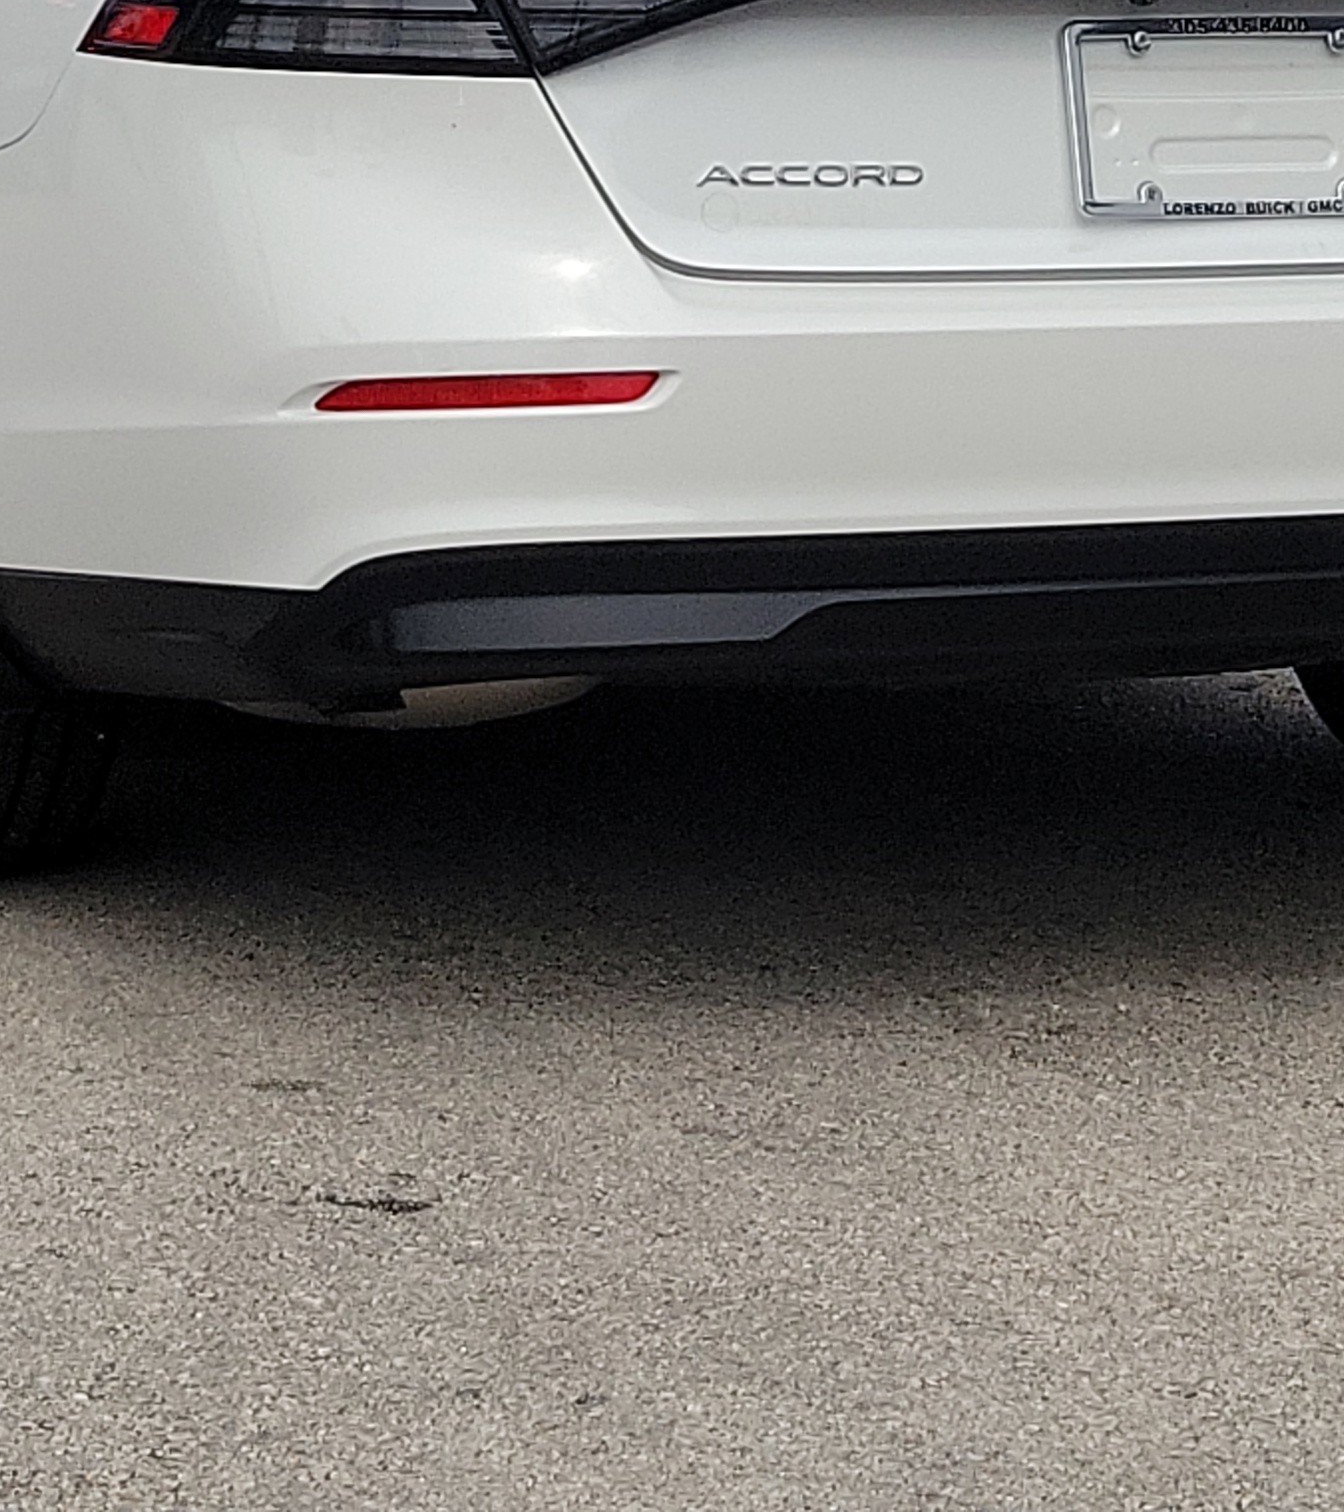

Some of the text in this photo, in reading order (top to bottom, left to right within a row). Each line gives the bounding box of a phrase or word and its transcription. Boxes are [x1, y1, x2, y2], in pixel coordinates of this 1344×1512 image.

[696, 164, 924, 188] ACCORD
[1163, 199, 1344, 216] LORENZO BUICK GMC
